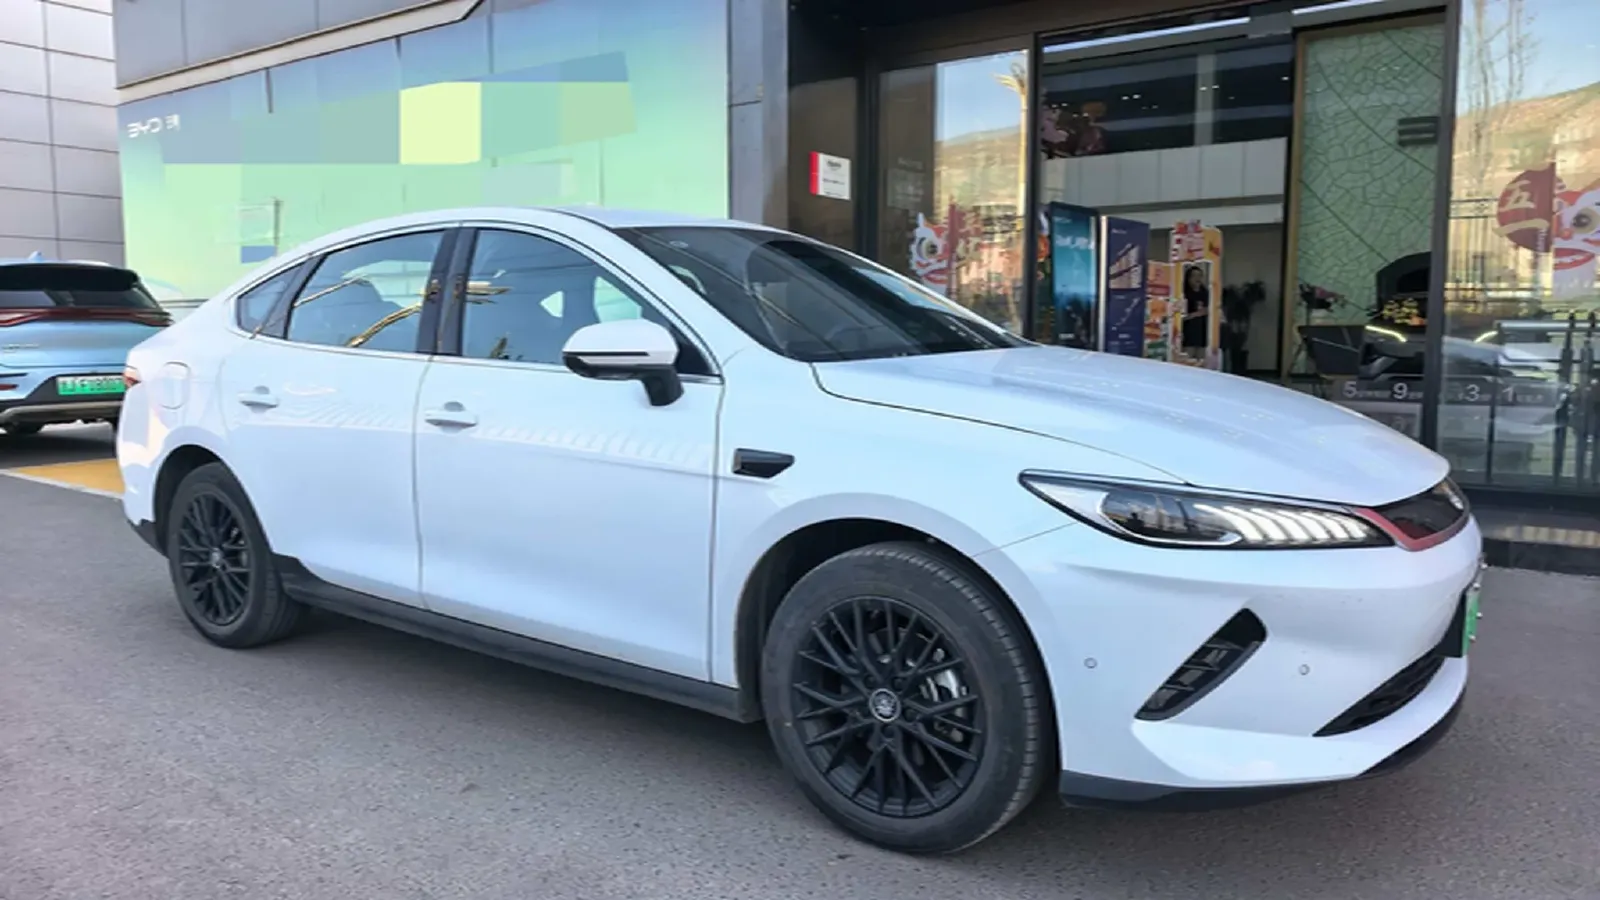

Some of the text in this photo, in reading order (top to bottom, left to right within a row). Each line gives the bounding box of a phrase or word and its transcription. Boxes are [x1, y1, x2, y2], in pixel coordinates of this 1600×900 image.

[1343, 381, 1357, 398] 5
[1393, 382, 1408, 399] 9
[1464, 384, 1481, 402] 3
